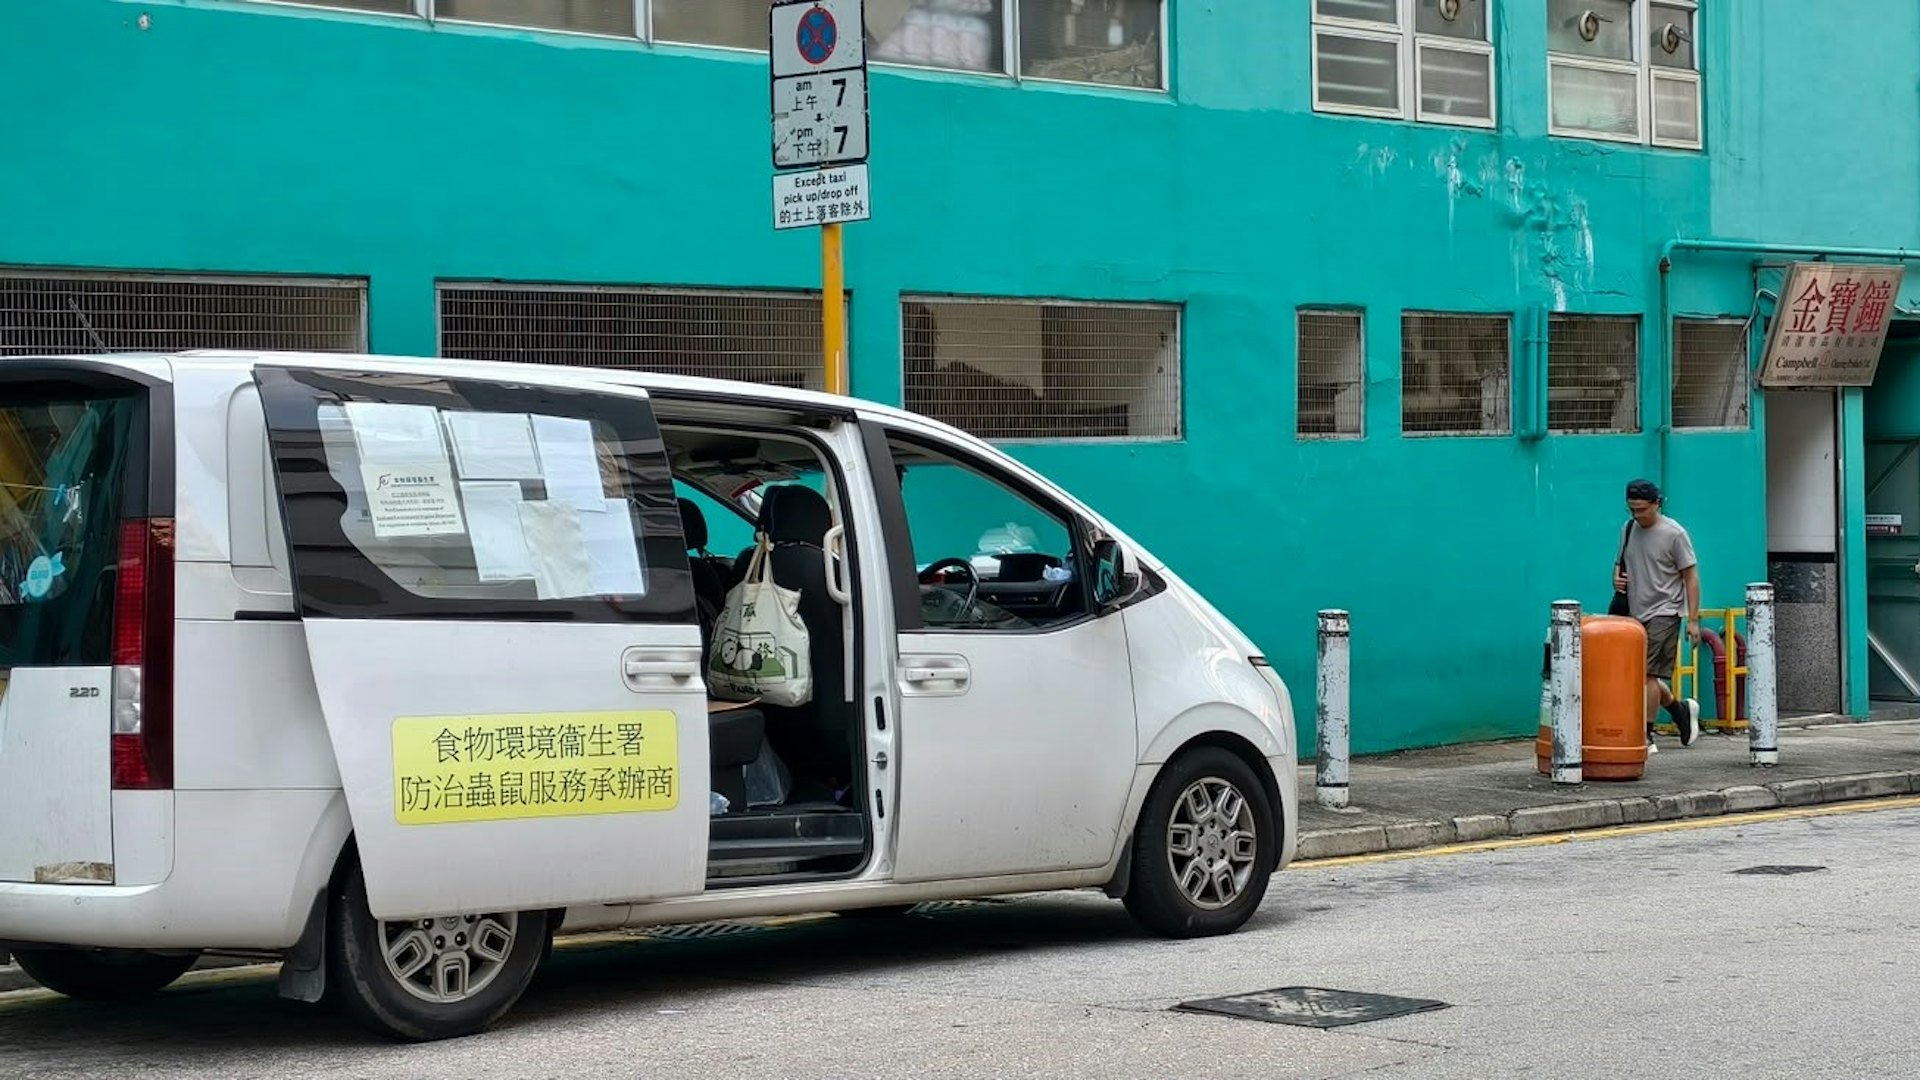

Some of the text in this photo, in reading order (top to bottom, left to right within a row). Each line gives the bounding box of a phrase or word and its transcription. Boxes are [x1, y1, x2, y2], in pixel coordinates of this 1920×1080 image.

[796, 81, 812, 91] am
[832, 78, 846, 107] 7
[792, 95, 817, 112] 上午
[797, 128, 813, 140] pm
[833, 125, 848, 154] 7
[793, 141, 821, 158] 下午
[795, 171, 847, 187] Except taxi
[784, 185, 858, 206] pick up/drop off
[780, 200, 864, 223] 的士上落客除外
[1785, 278, 1891, 335] 金寶鐘
[1776, 353, 1818, 371] Campbell
[400, 765, 673, 812] 防治蟲鼠服務承辦商
